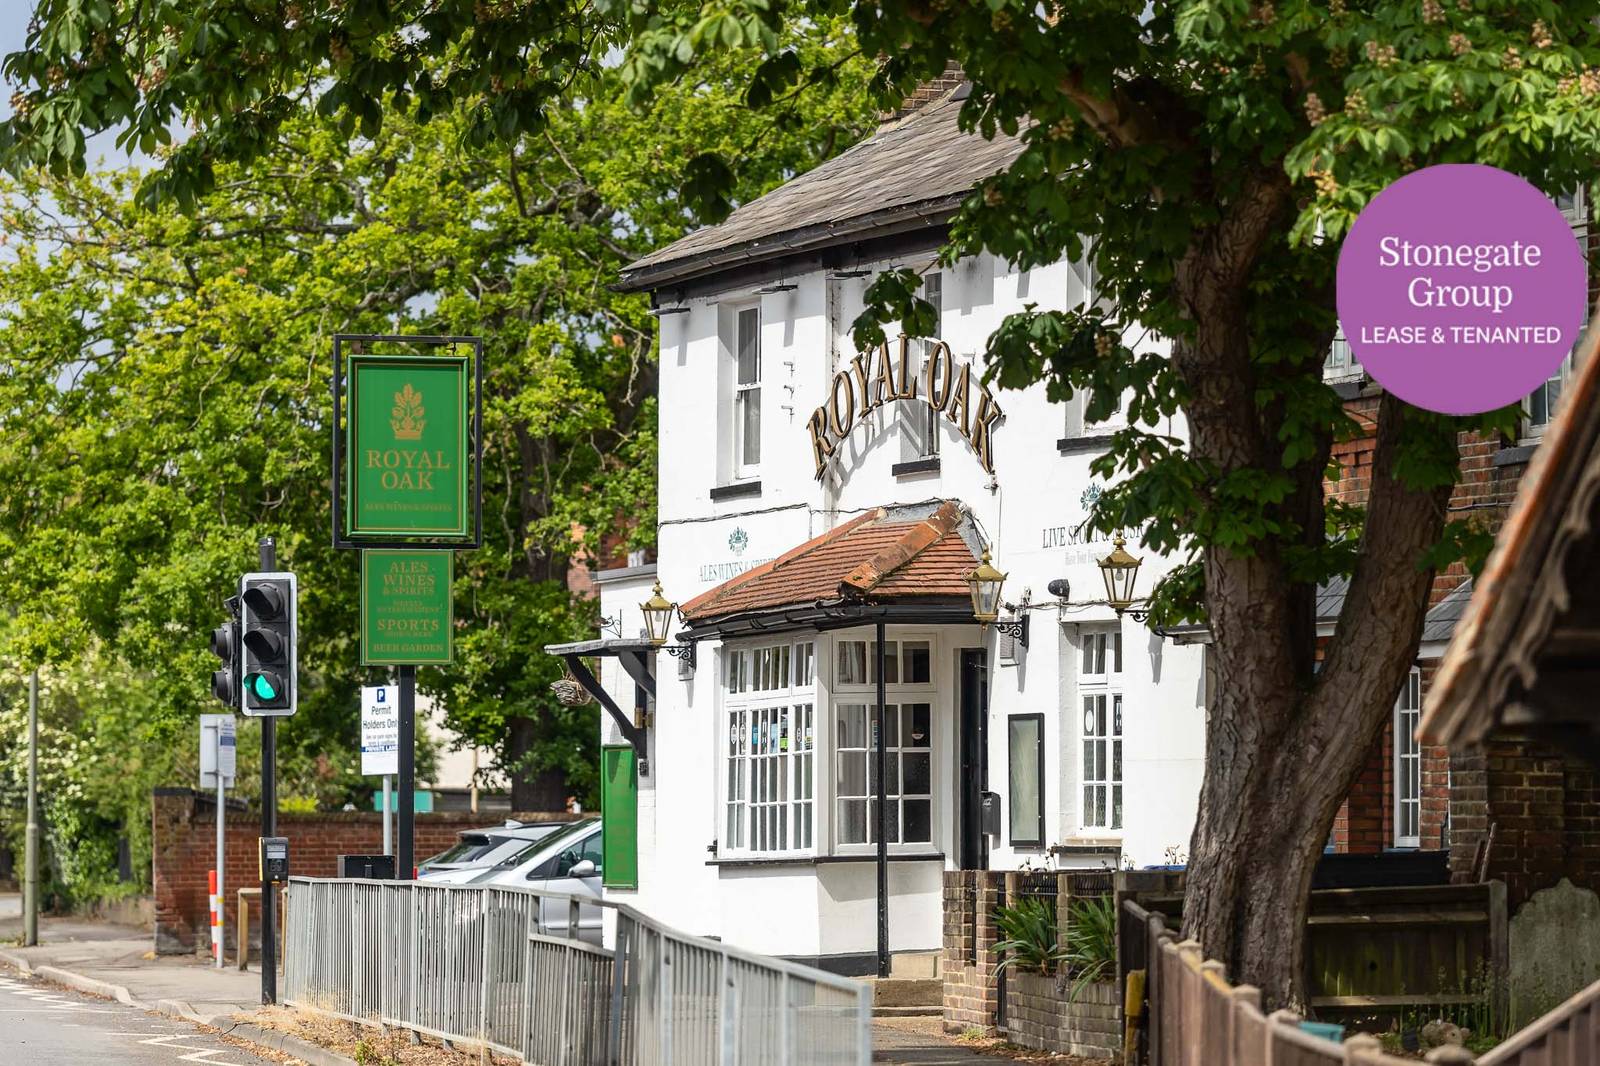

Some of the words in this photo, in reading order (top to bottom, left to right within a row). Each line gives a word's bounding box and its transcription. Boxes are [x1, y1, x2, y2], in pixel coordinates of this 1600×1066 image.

[806, 333, 917, 481] ROYAL
[926, 341, 1004, 474] OAK
[366, 450, 450, 469] ROYAL
[381, 471, 434, 490] OAK
[1042, 527, 1065, 549] LIVE
[1068, 523, 1099, 546] SPOT
[390, 561, 428, 573] ALES
[383, 574, 435, 586] WINES
[377, 619, 439, 631] SPORTS
[371, 706, 391, 715] Permit
[362, 720, 386, 729] Holders
[387, 718, 398, 728] Onl
